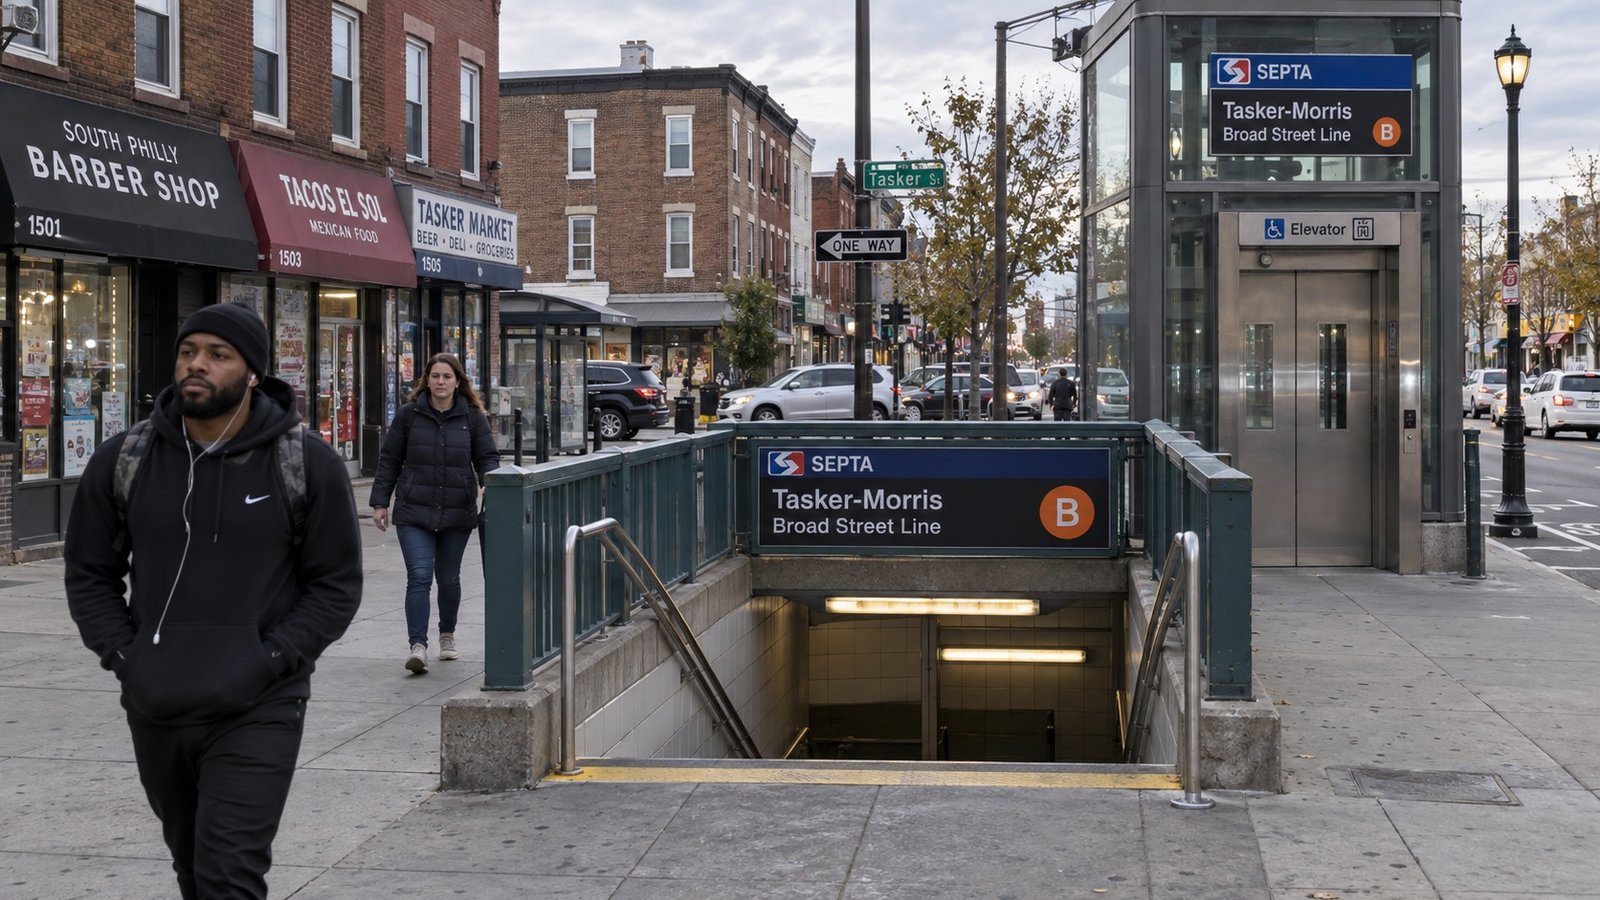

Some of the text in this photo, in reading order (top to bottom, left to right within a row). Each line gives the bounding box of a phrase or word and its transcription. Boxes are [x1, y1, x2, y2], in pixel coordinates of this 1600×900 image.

[1257, 63, 1313, 80] SEPTA
[1222, 101, 1353, 120] Tasker-Morris
[1223, 126, 1351, 142] Broad Street Line
[1380, 123, 1394, 141] B
[62, 120, 179, 165] SOUTH PHILLY
[26, 144, 220, 209] BARBER SHOP
[869, 171, 921, 187] Tasker
[279, 173, 388, 224] TACOS EL SOL
[28, 214, 62, 238] 1501
[417, 198, 513, 243] TASKER MARKET
[1290, 222, 1346, 236] Elevator
[309, 218, 379, 244] MEXICAN FOOD
[416, 229, 515, 260] BEER DELI GROCERIES
[833, 239, 895, 252] ONE WAY
[278, 249, 302, 268] 1503
[811, 455, 874, 473] SEPTA
[772, 488, 943, 511] Tasker-Morris
[1056, 498, 1080, 527] B
[772, 517, 942, 535] Broad Street Line
